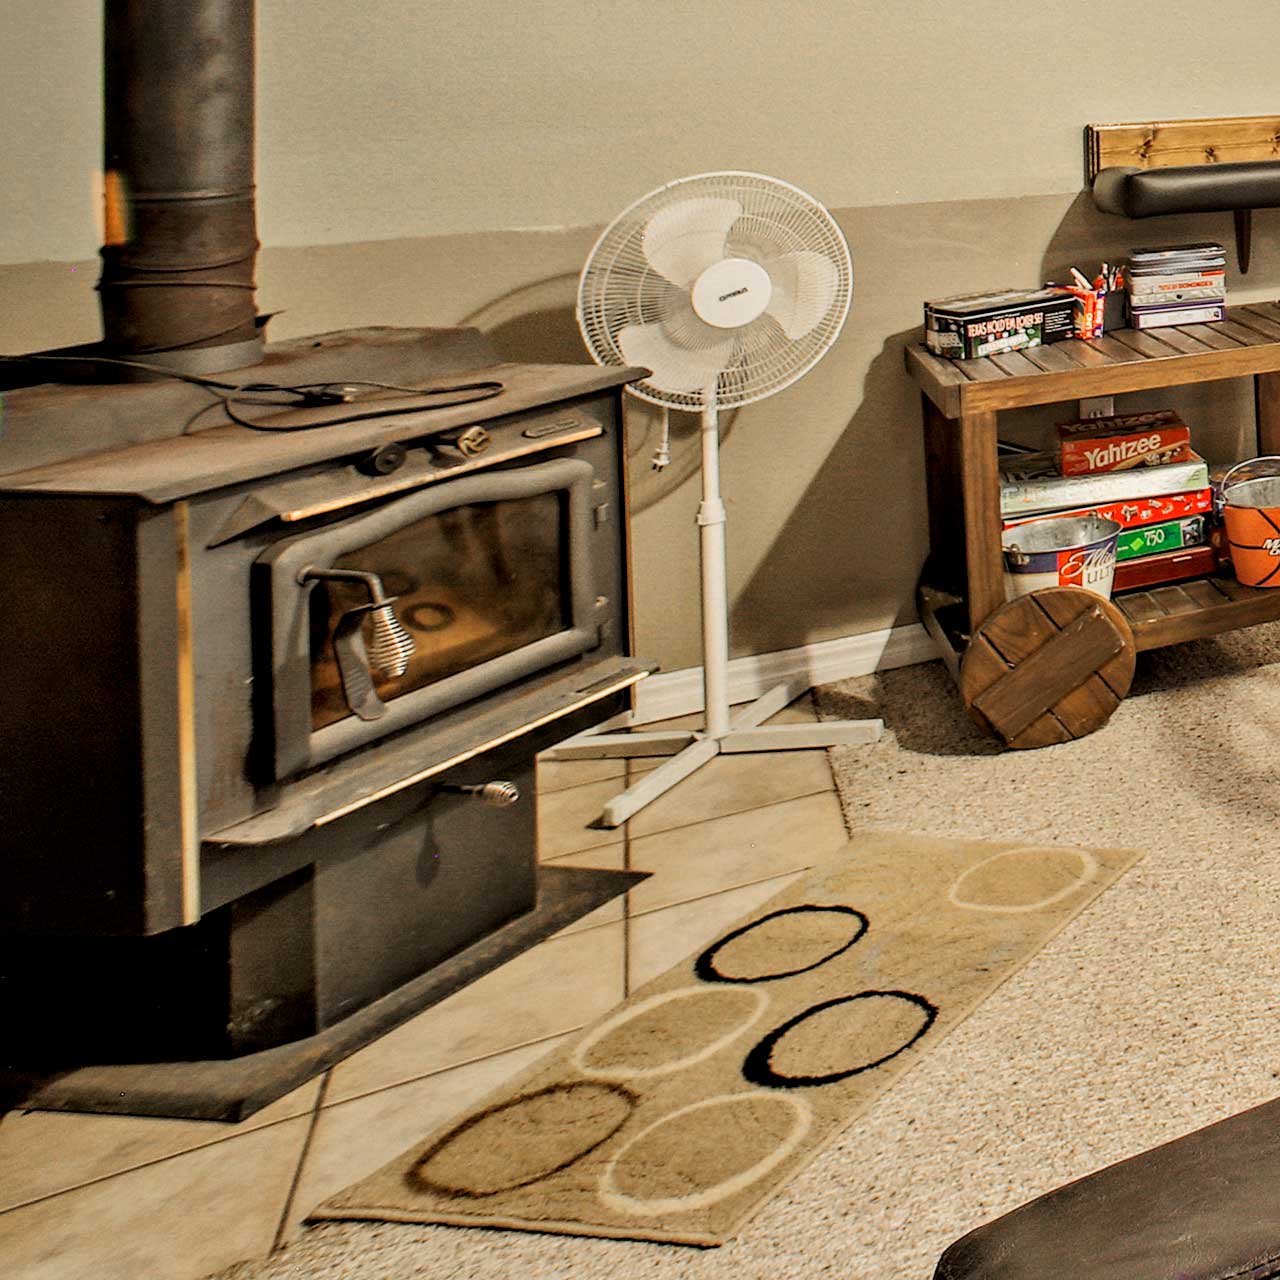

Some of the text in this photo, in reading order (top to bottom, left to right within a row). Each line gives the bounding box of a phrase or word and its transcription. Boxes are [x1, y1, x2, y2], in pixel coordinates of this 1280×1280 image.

[968, 322, 987, 337] TEXAS
[1084, 434, 1162, 470] Yahtzee
[1144, 529, 1165, 546] 750
